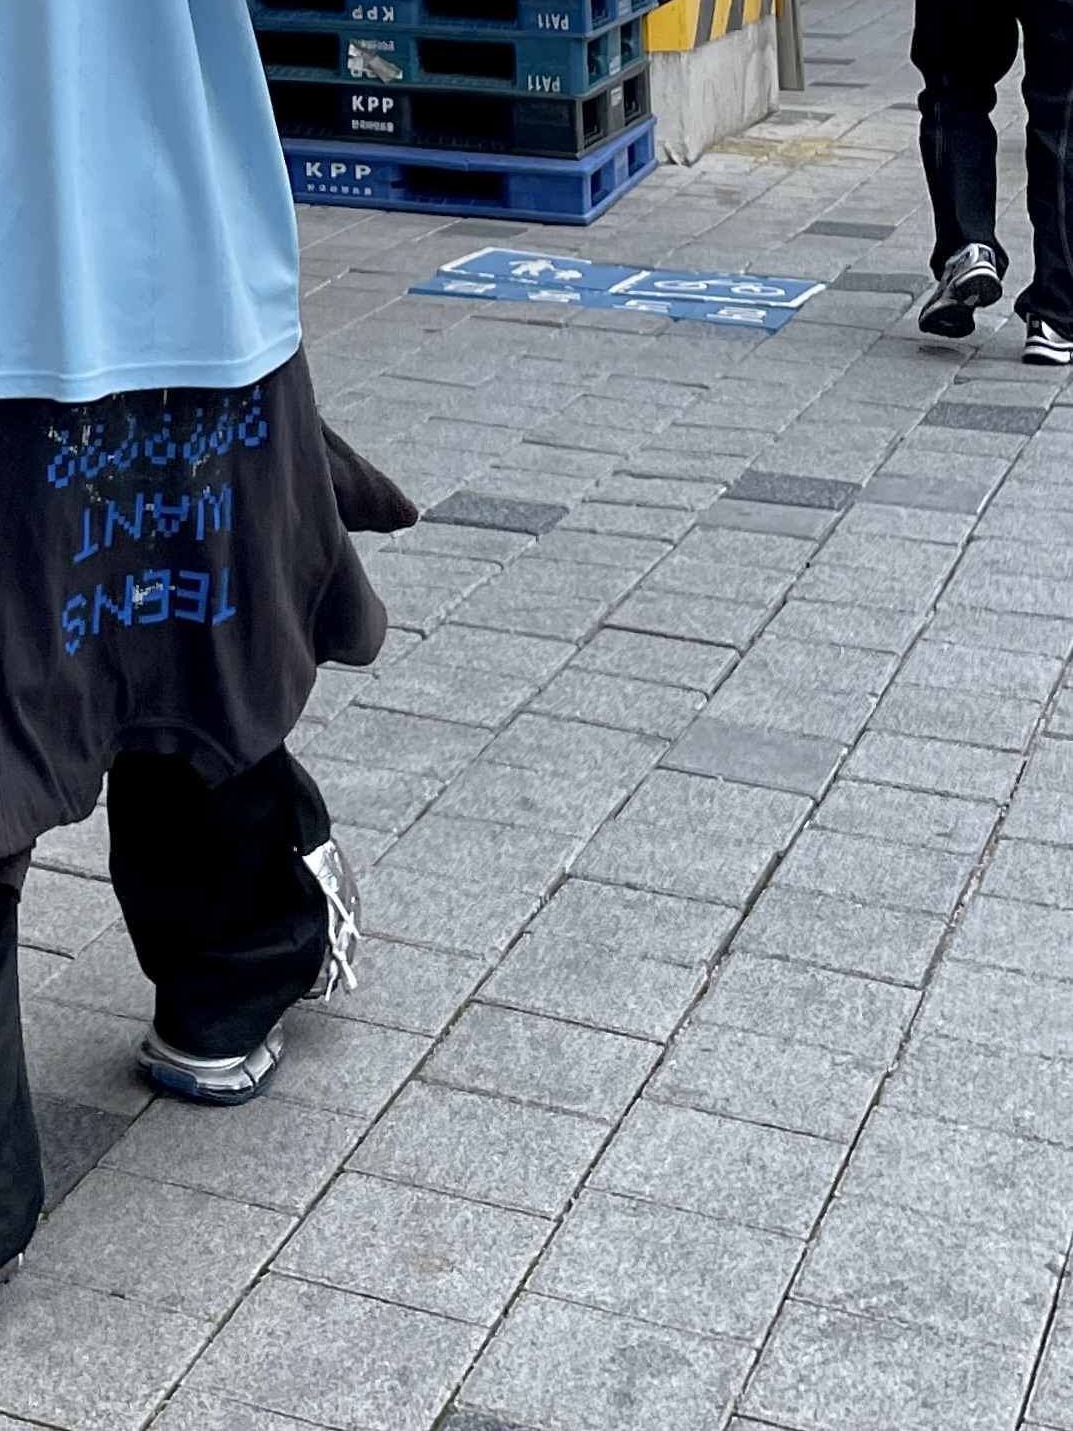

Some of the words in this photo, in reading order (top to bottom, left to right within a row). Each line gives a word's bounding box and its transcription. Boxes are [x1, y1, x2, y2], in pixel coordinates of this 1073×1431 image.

[352, 4, 394, 21] KPP
[537, 13, 569, 31] PA11
[527, 74, 561, 93] PA11
[351, 95, 394, 114] KPP
[306, 162, 372, 180] KPP
[73, 482, 234, 563] WANT
[61, 567, 236, 656] TEENS
